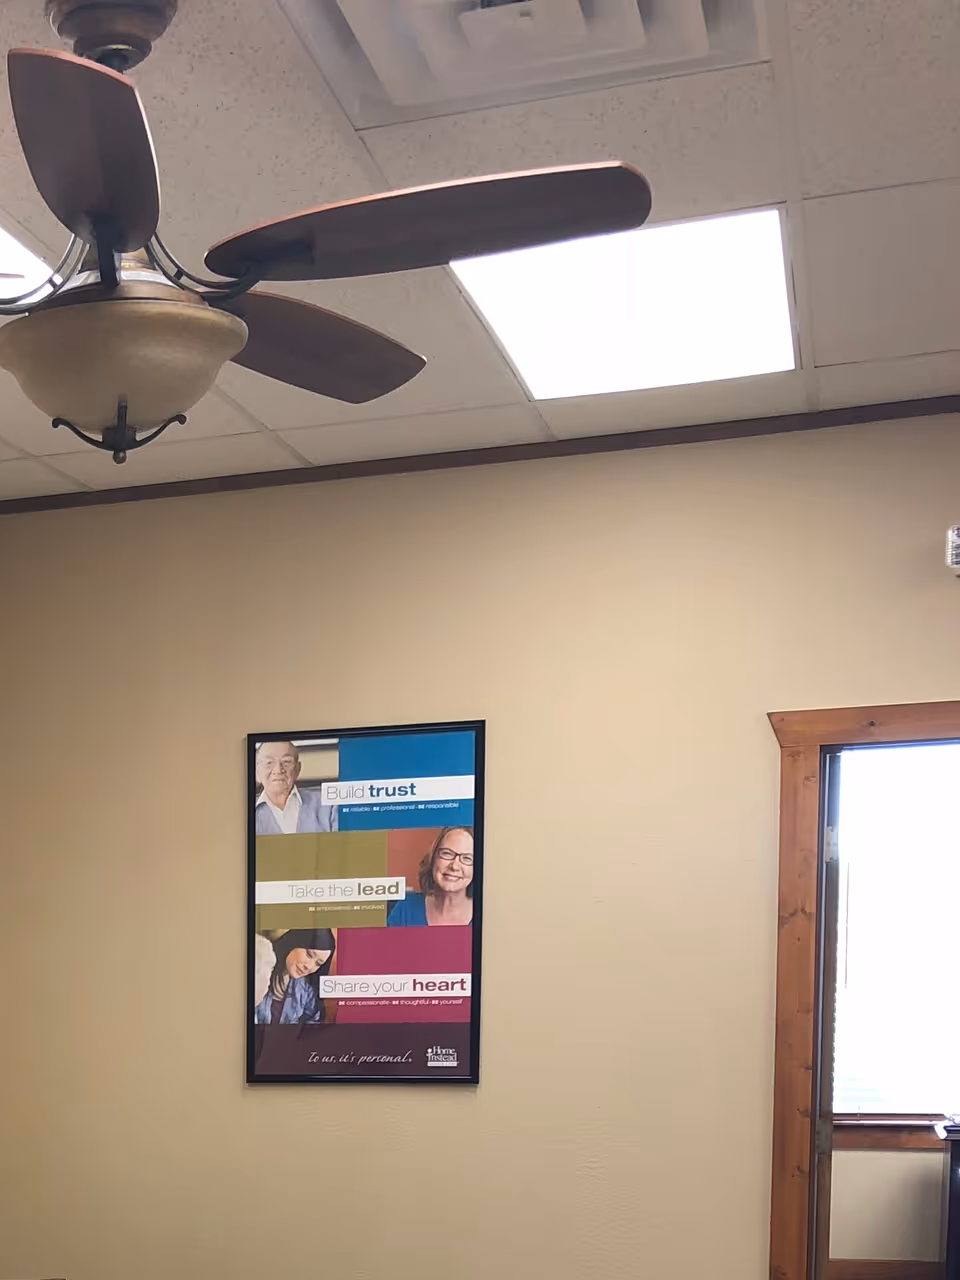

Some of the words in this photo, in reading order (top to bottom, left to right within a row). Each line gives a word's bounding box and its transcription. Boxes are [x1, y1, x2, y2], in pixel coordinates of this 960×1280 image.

[326, 784, 365, 800] Build
[368, 783, 417, 798] trust
[381, 804, 415, 812] professional
[288, 884, 325, 899] Take
[328, 883, 354, 897] the
[357, 881, 400, 896] lead
[322, 979, 370, 993] Share
[372, 981, 408, 996] your
[412, 978, 467, 992] heart
[308, 1051, 320, 1063] To
[321, 1055, 336, 1063] us,
[338, 1052, 356, 1063] it's
[357, 1049, 412, 1066] personal.
[433, 1046, 456, 1055] Home
